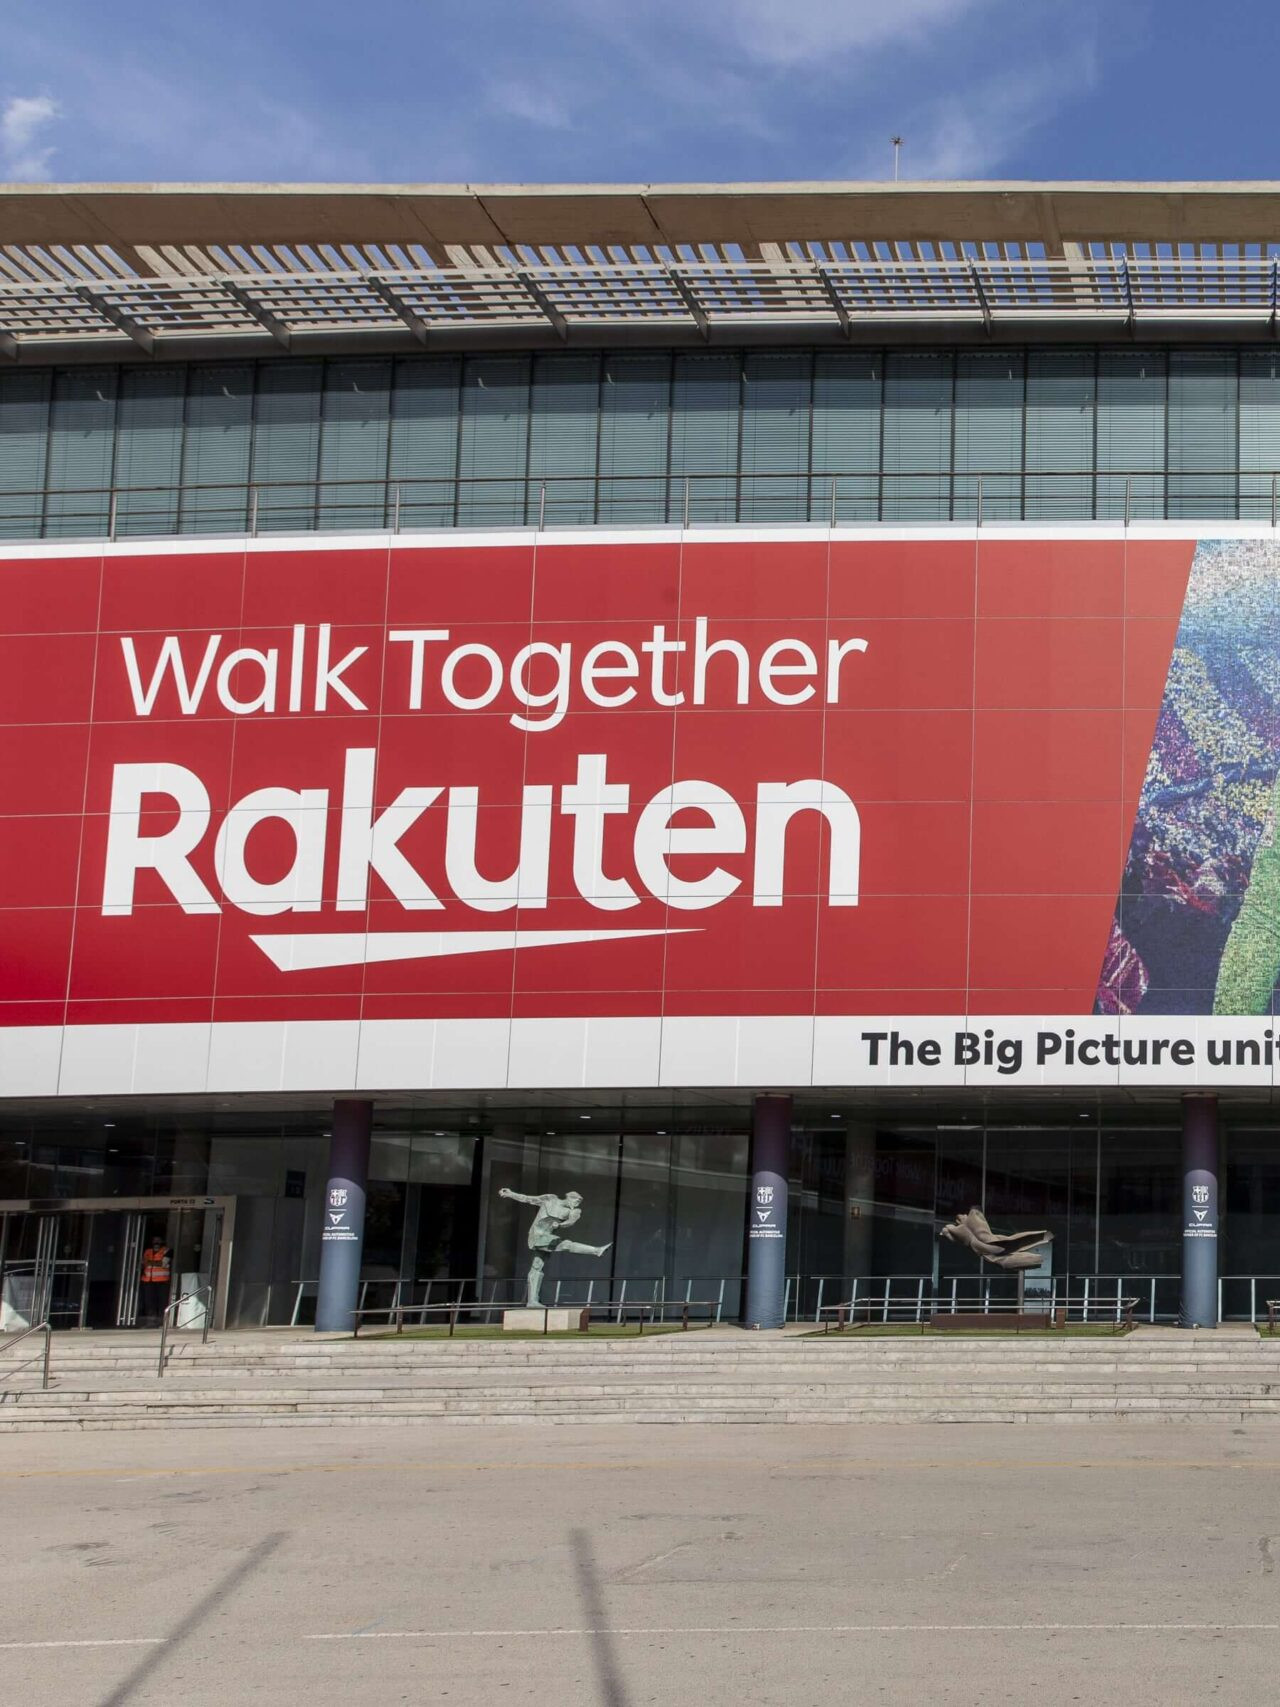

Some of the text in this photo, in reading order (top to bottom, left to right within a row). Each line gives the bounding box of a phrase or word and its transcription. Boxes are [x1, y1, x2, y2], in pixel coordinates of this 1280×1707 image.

[121, 617, 868, 731] Walk Together
[102, 748, 860, 915] Rakuten
[862, 1032, 941, 1065] The
[955, 1031, 1022, 1074] Big
[1037, 1031, 1194, 1065] Picture
